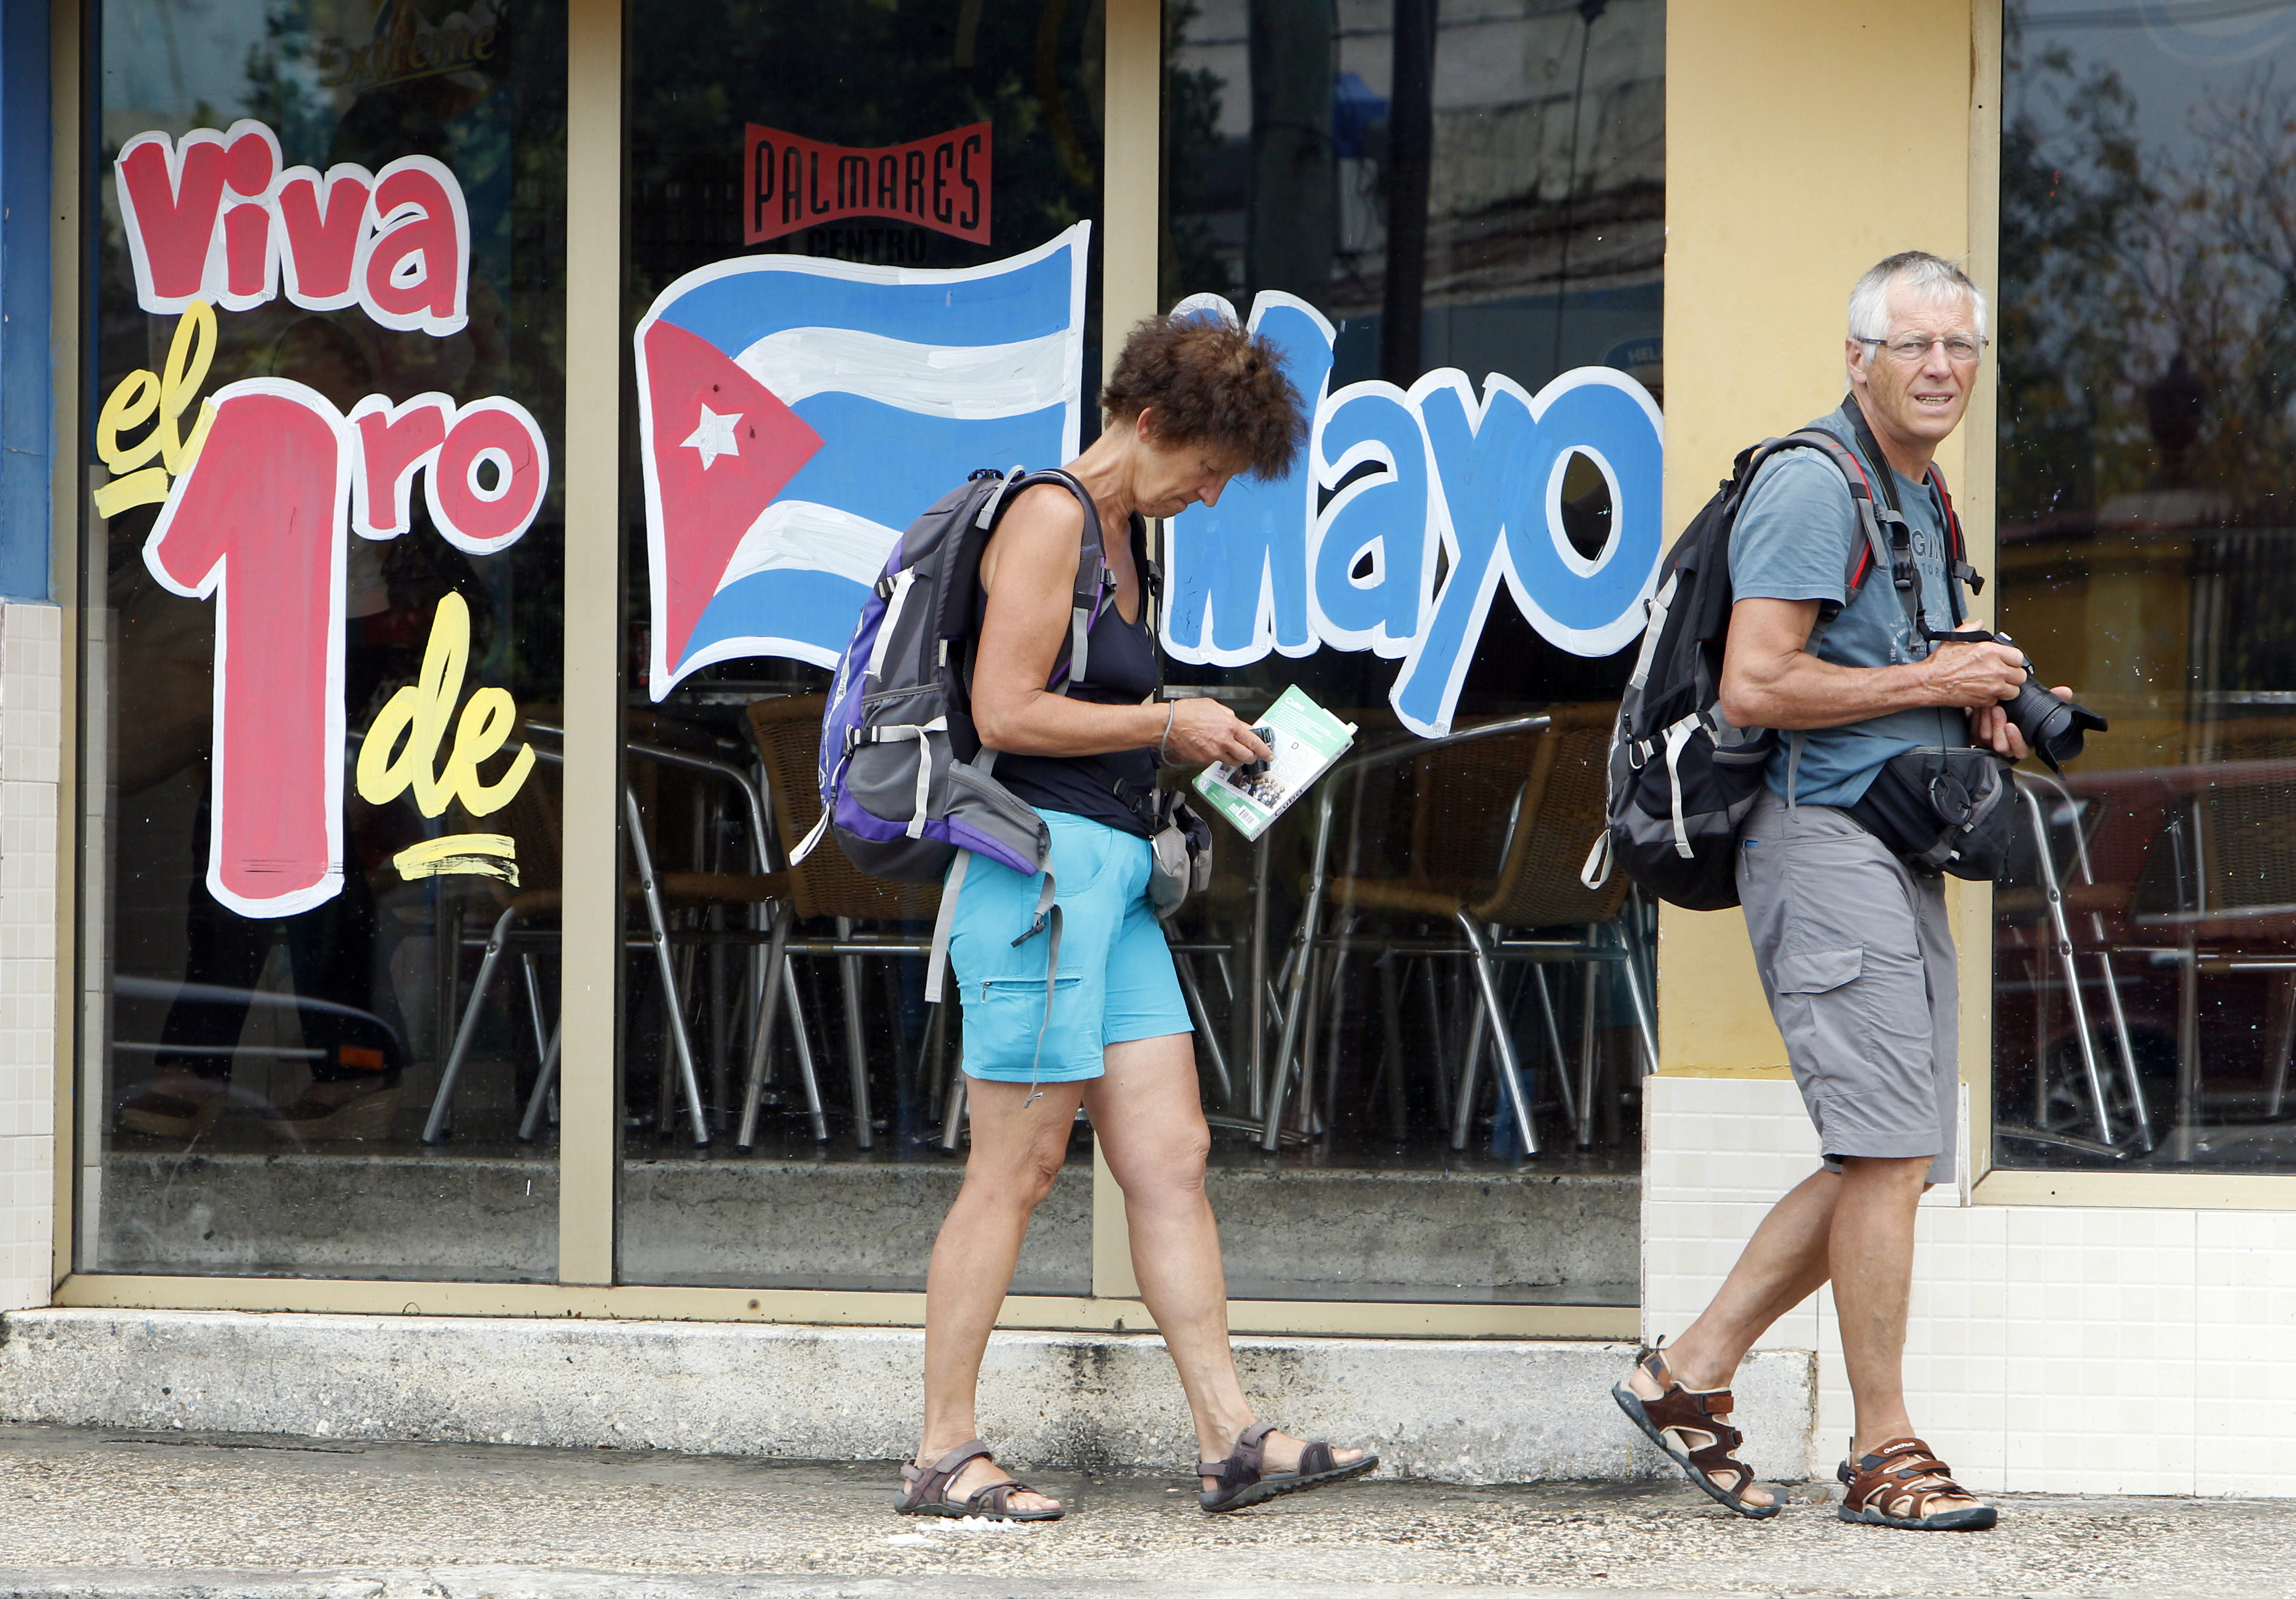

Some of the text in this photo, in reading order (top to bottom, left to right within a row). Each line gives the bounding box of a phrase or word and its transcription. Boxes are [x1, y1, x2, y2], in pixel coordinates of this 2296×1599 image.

[318, 24, 497, 87] Extreme
[115, 118, 471, 337] Viva
[754, 134, 982, 233] PALMARES
[807, 227, 927, 263] CENTRO
[96, 300, 218, 477] el
[142, 376, 549, 918] 1ro
[356, 591, 536, 818] de
[1285, 696, 1306, 712] Cuba
[1274, 788, 1303, 816] Cuba
